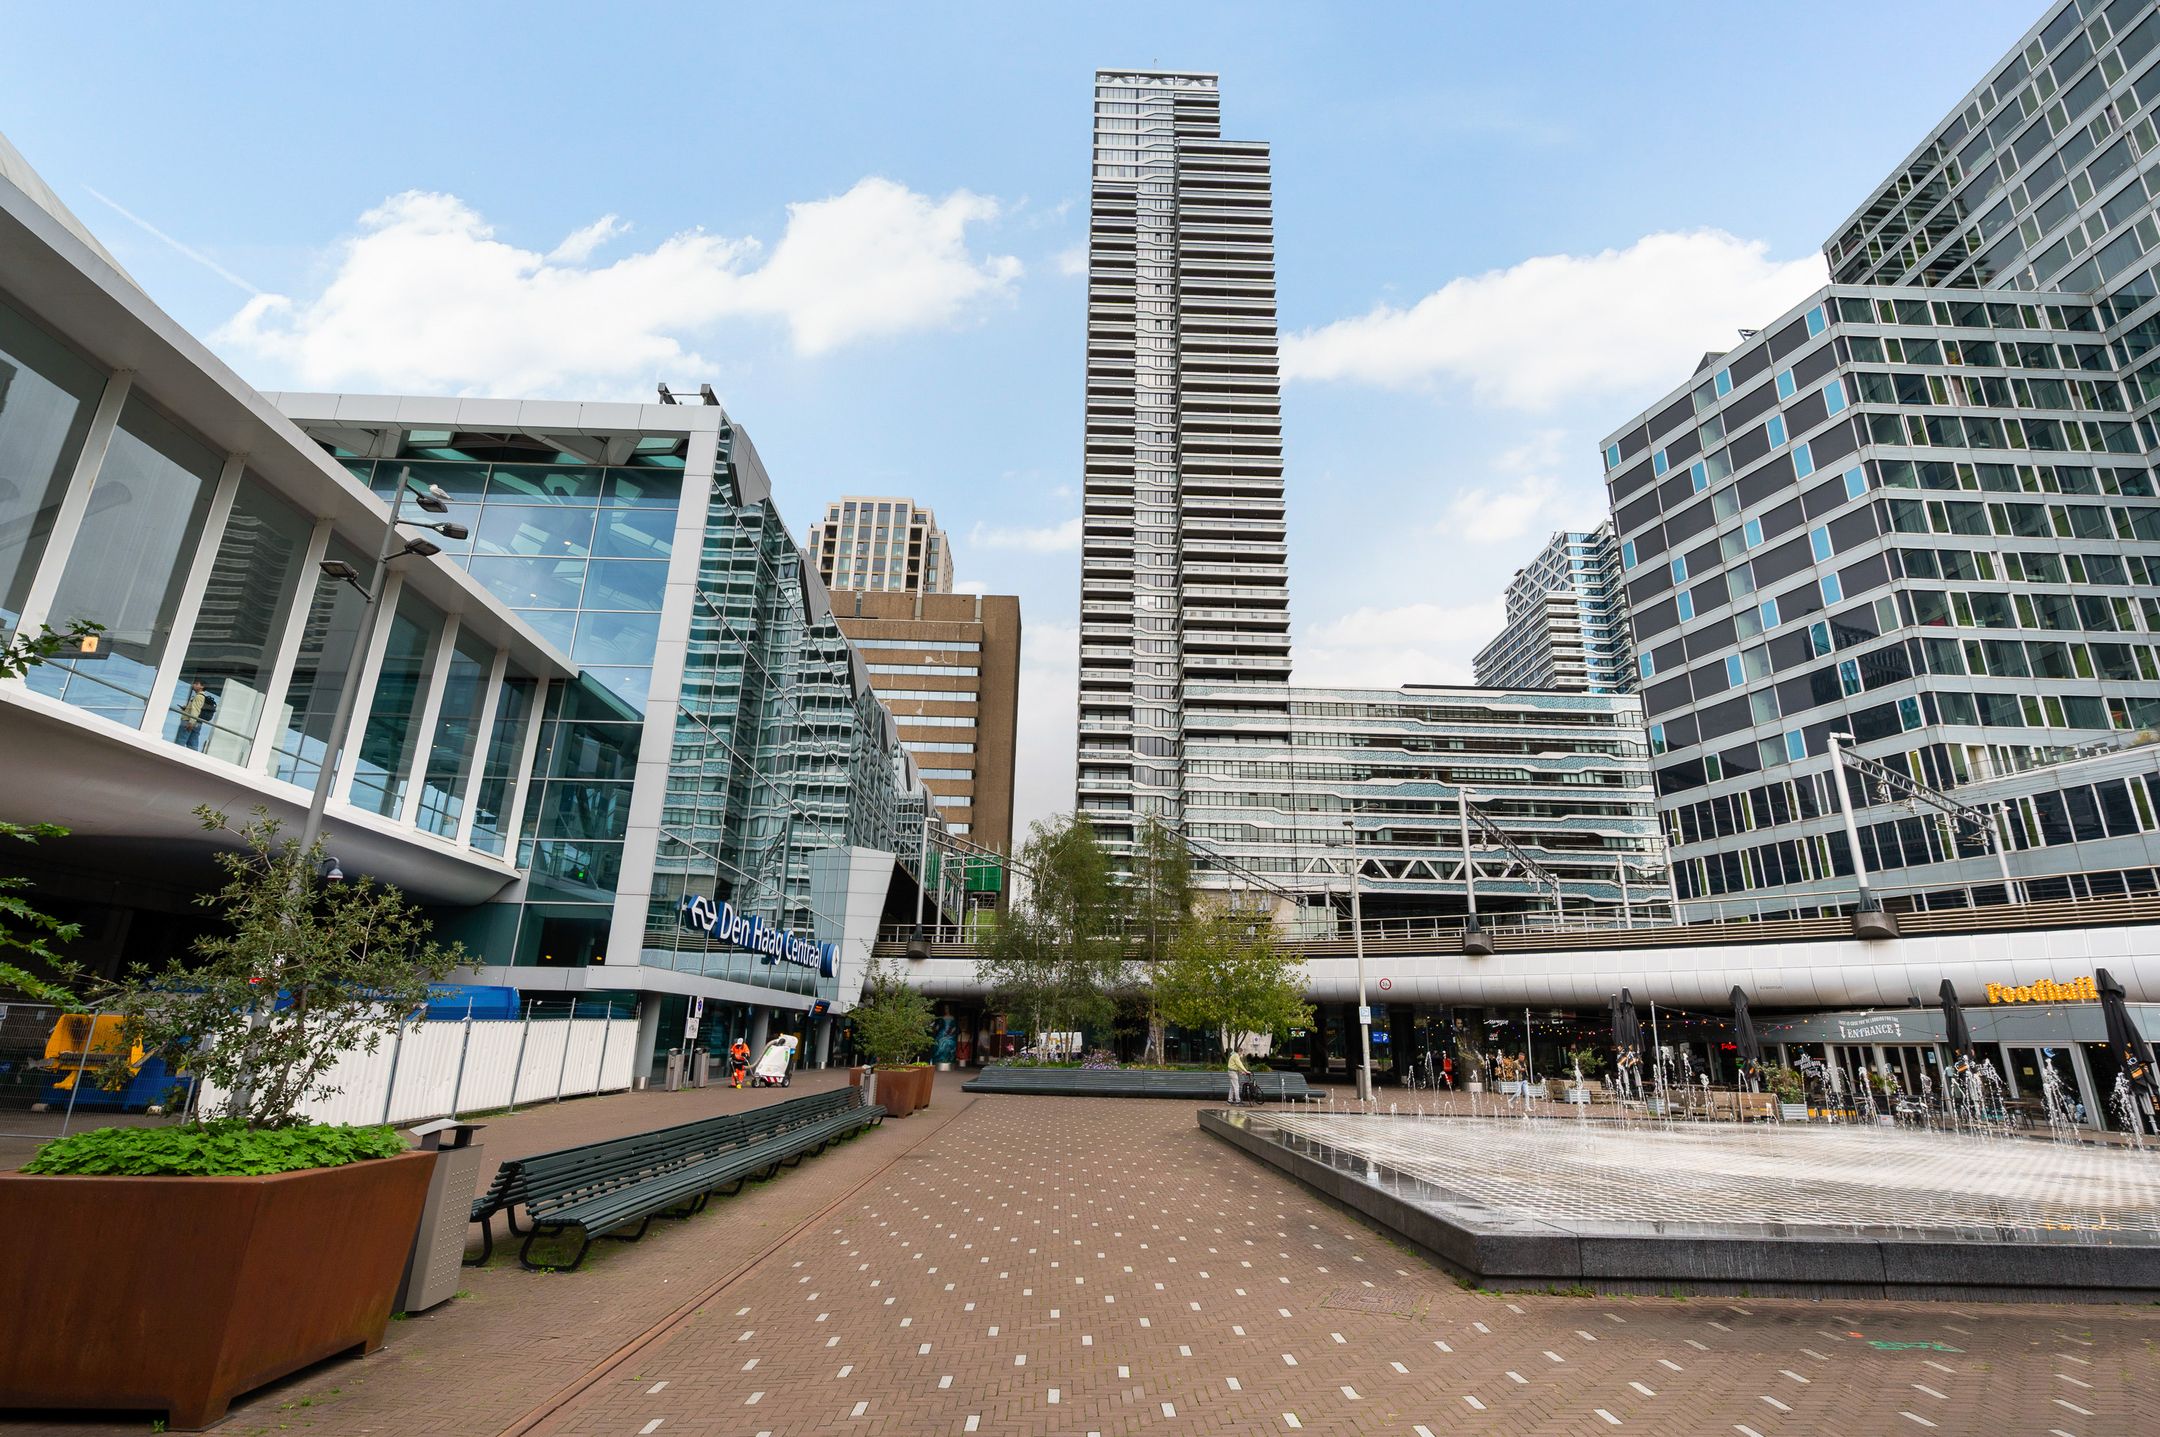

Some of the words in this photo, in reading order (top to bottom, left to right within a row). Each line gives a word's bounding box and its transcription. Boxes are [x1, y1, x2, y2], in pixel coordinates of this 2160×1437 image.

[720, 902, 750, 946] Den
[752, 915, 784, 966] Haag
[785, 929, 824, 969] Centraal
[1985, 976, 2098, 1004] Foodhall
[1846, 1024, 1894, 1038] ENTRANCE
